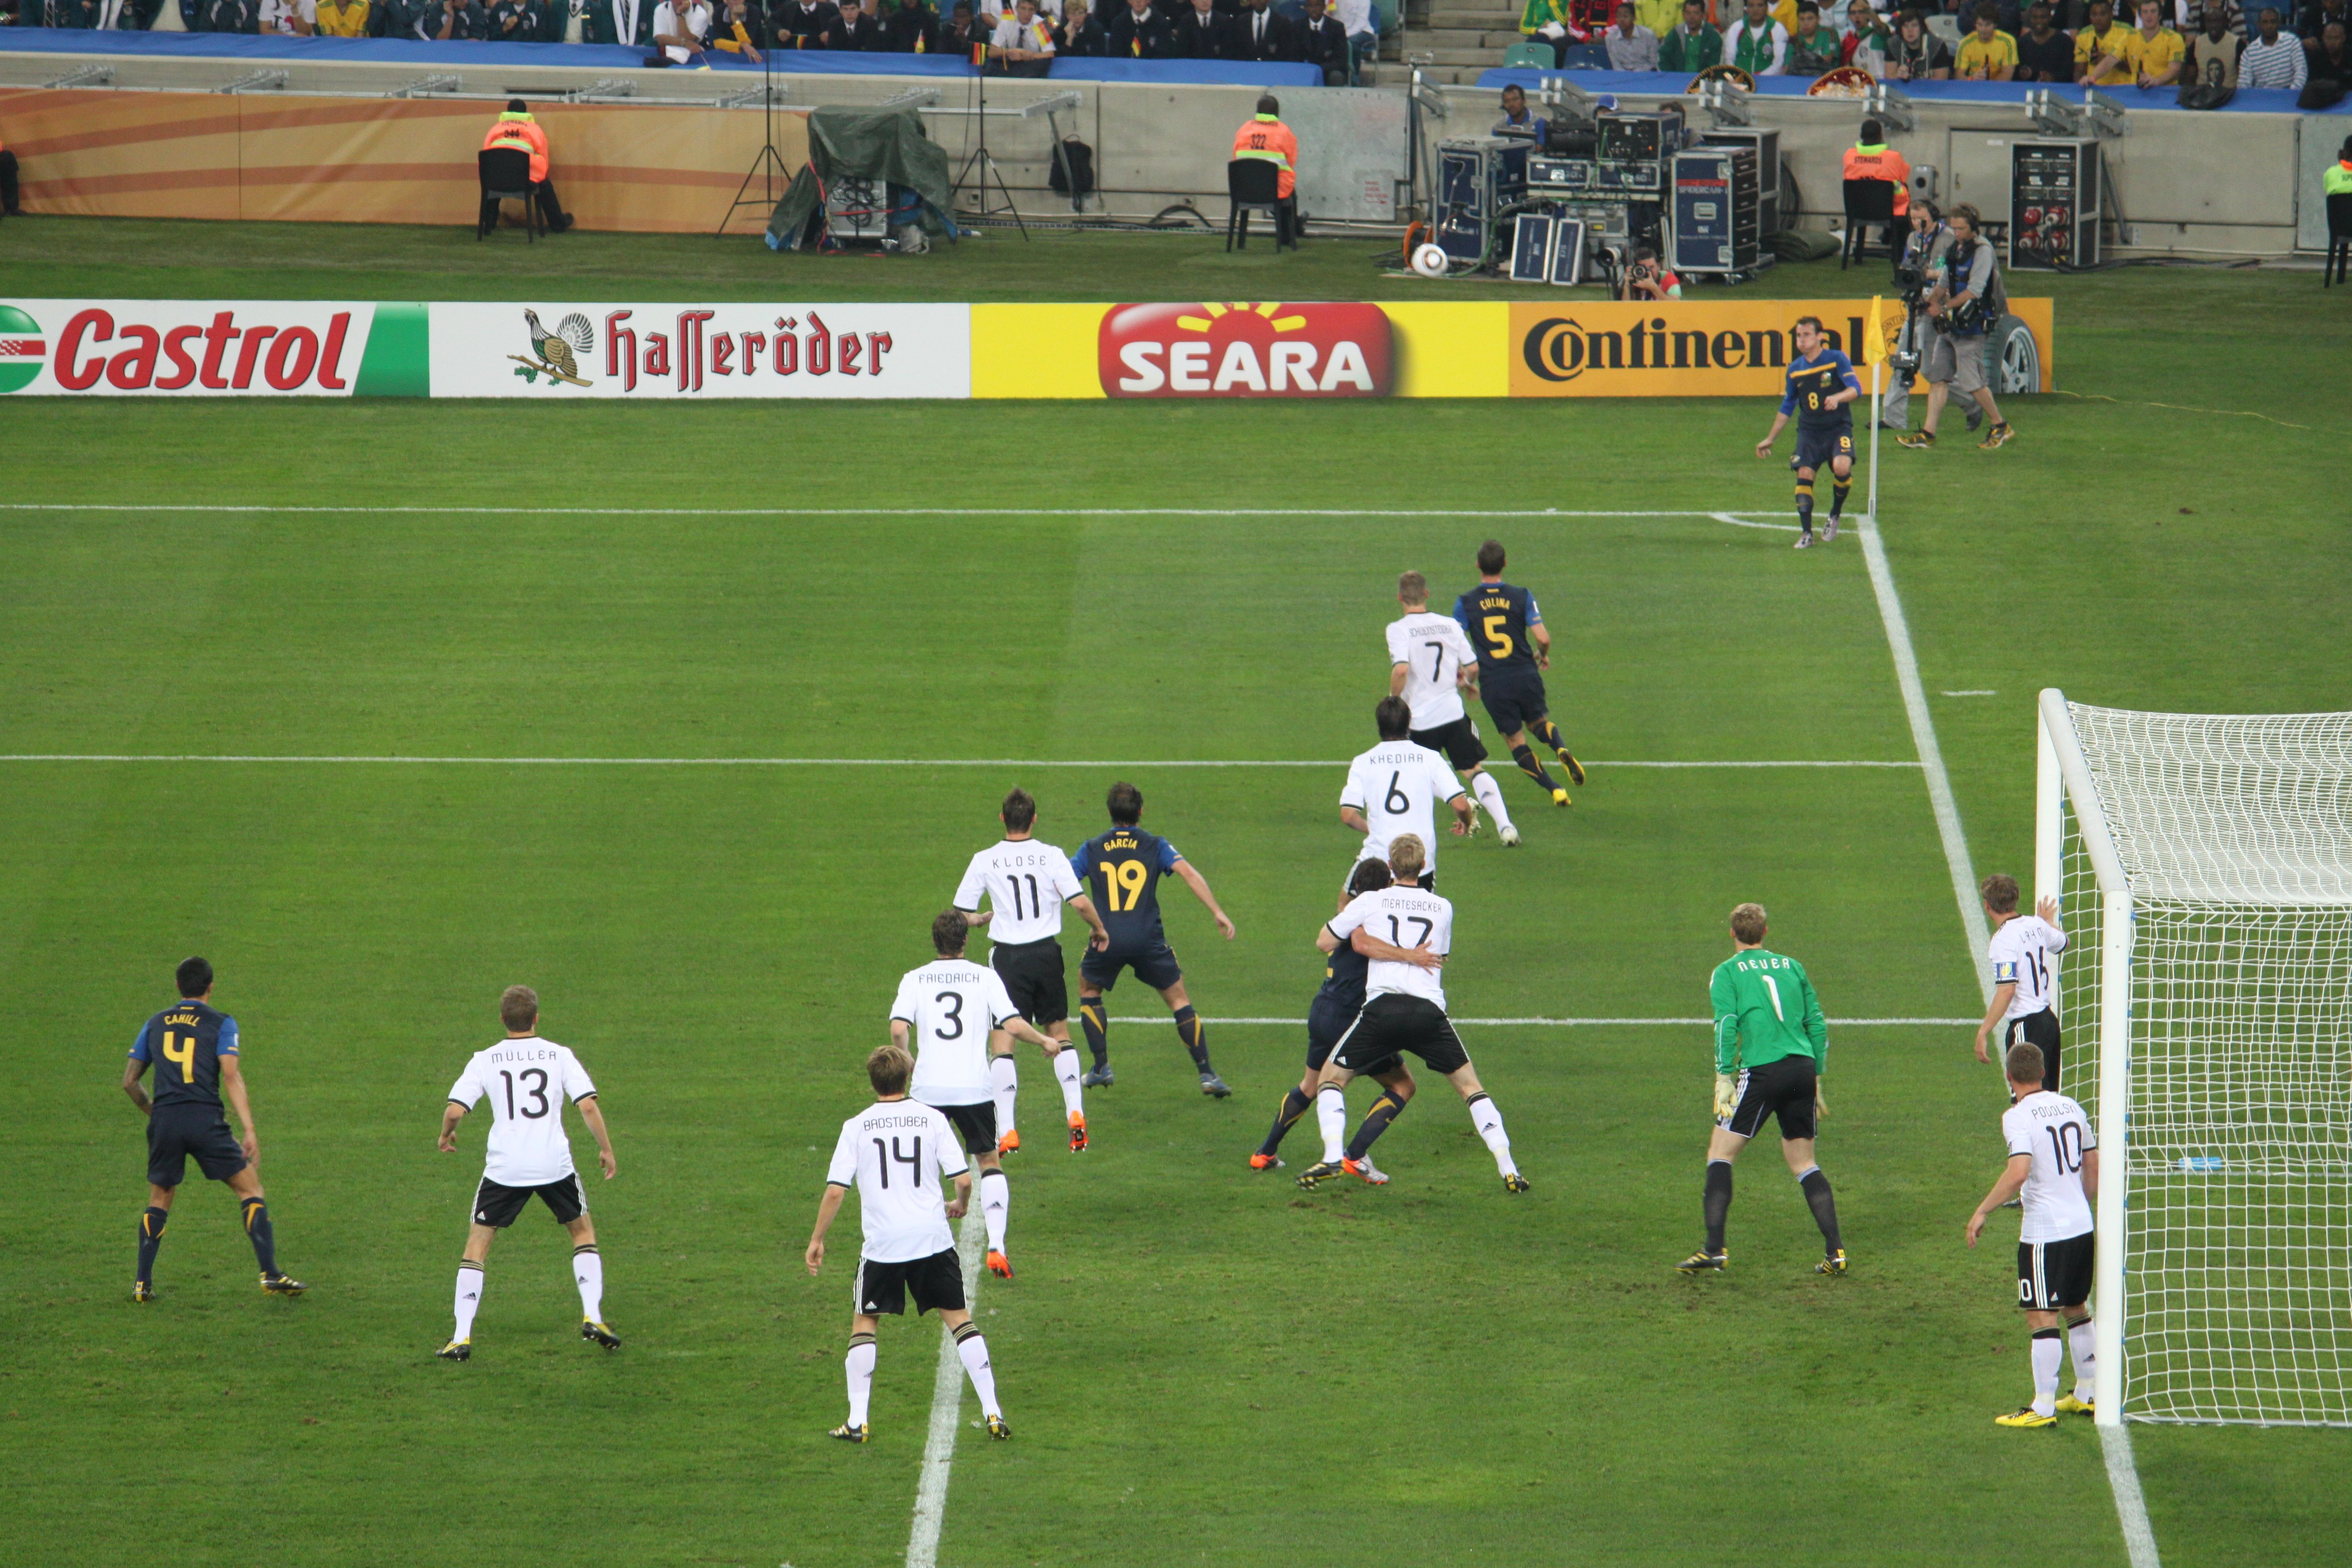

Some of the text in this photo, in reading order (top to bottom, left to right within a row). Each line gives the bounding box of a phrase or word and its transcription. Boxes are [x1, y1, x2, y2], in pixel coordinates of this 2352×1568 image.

[54, 308, 351, 390] Castrol
[1120, 341, 1374, 392] SEARA
[1809, 392, 1818, 410] 8
[1840, 436, 1851, 448] 8
[1479, 597, 1511, 610] CULINA
[1483, 615, 1514, 659] 5
[1425, 641, 1443, 682] 7
[1371, 753, 1423, 765] KHEDIRA
[1385, 770, 1409, 815] 6
[1104, 838, 1138, 852] GARCIA
[993, 855, 1046, 869] KLOSE
[1007, 874, 1039, 921] 11
[1100, 859, 1147, 912] 19
[1382, 898, 1442, 914] MERTESACKER
[1388, 914, 1433, 947] 17
[2019, 927, 2044, 943] LAHM
[1738, 958, 1790, 972] NEUER
[919, 973, 980, 984] FRIEDRICH
[1762, 975, 1784, 1022] 1
[164, 1014, 200, 1027] CAHILL
[935, 991, 963, 1040] 3
[163, 1031, 196, 1083] 4
[491, 1050, 556, 1063] MÜLLER
[500, 1068, 548, 1120] 13
[864, 1116, 928, 1131] BADSTUBER
[2032, 1103, 2078, 1120] PODOLSKI
[2046, 1121, 2082, 1176] 10
[873, 1136, 921, 1189] 14
